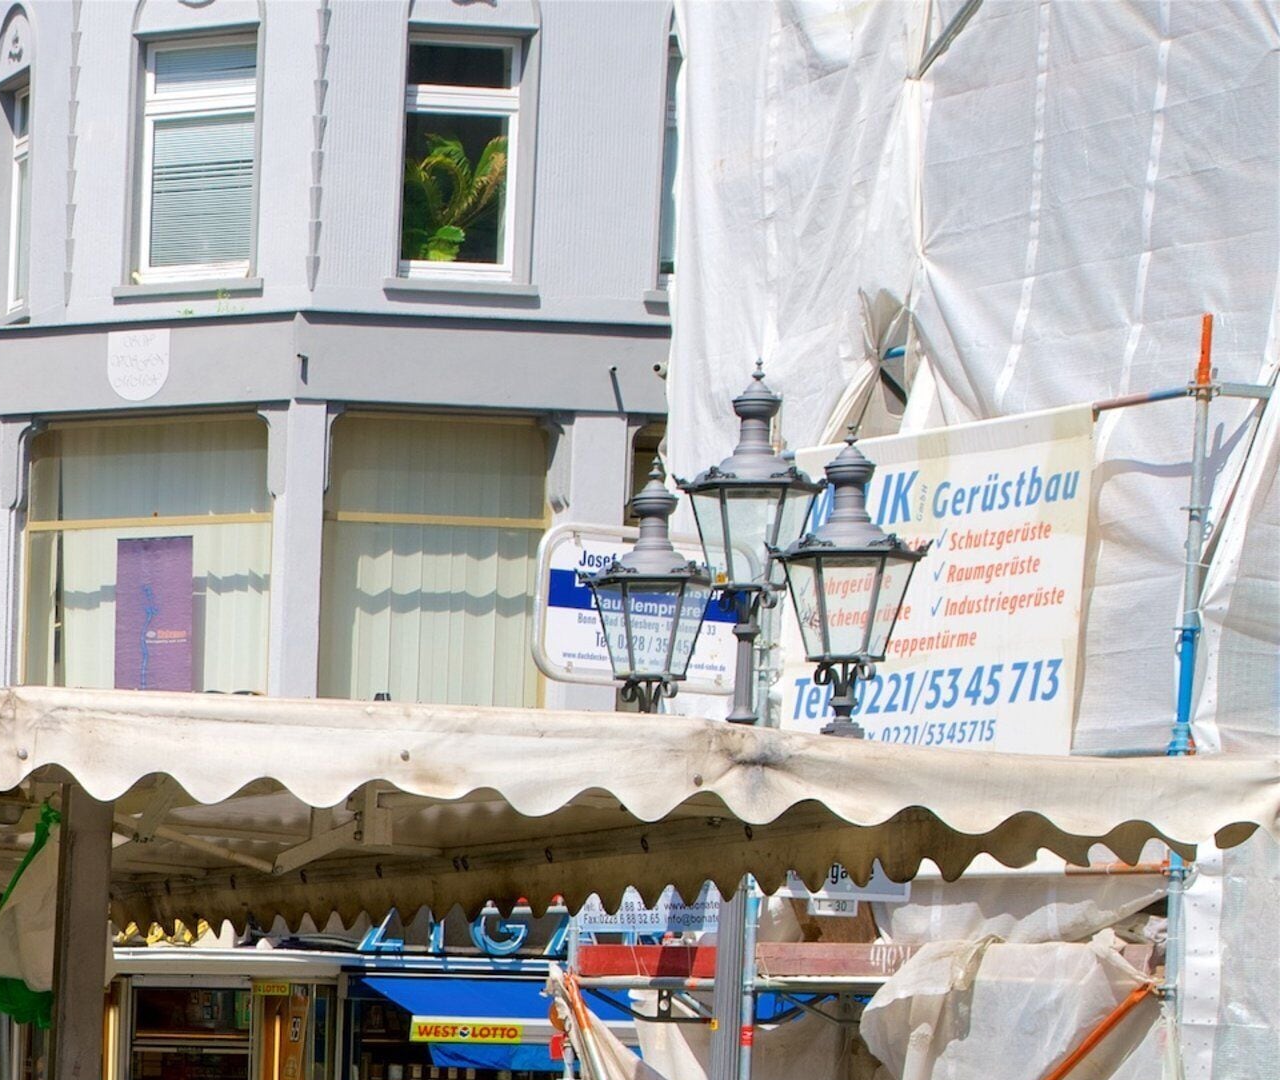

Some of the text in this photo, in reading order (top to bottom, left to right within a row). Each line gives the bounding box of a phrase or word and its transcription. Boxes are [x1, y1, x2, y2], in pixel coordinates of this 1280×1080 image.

[931, 466, 1081, 519] Gerüstbau
[948, 521, 1053, 551] Schutzgerüste
[946, 555, 1041, 583] Raumgerüste
[943, 586, 1066, 616] Industriegerüste
[707, 623, 717, 636] 33
[417, 1025, 519, 1039] WEST LOTTO
